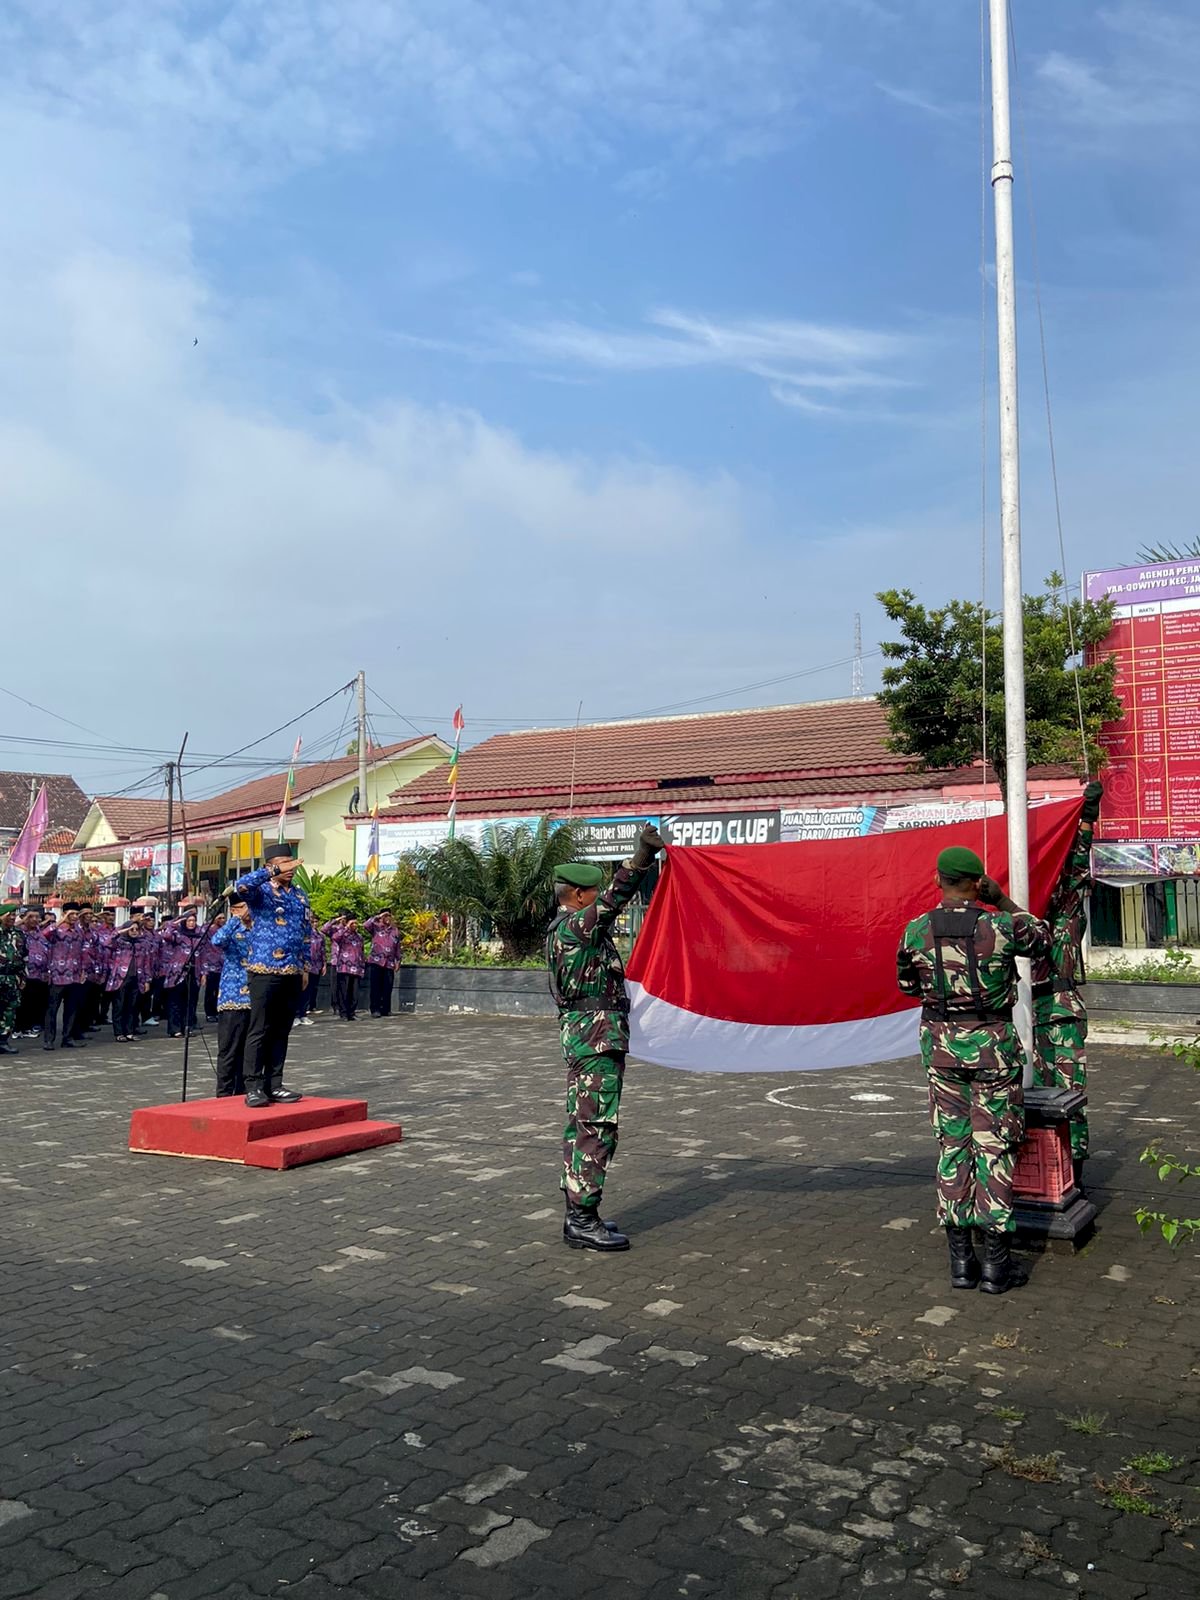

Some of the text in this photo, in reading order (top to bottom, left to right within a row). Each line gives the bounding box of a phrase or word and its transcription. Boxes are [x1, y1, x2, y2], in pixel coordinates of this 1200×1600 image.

[1140, 568, 1174, 580] AGENDA
[783, 811, 864, 826] JUAL BELI GENTENG
[590, 826, 615, 840] Barber
[617, 824, 636, 839] SHOP
[800, 828, 824, 840] BARU
[832, 828, 861, 839] BEKAS
